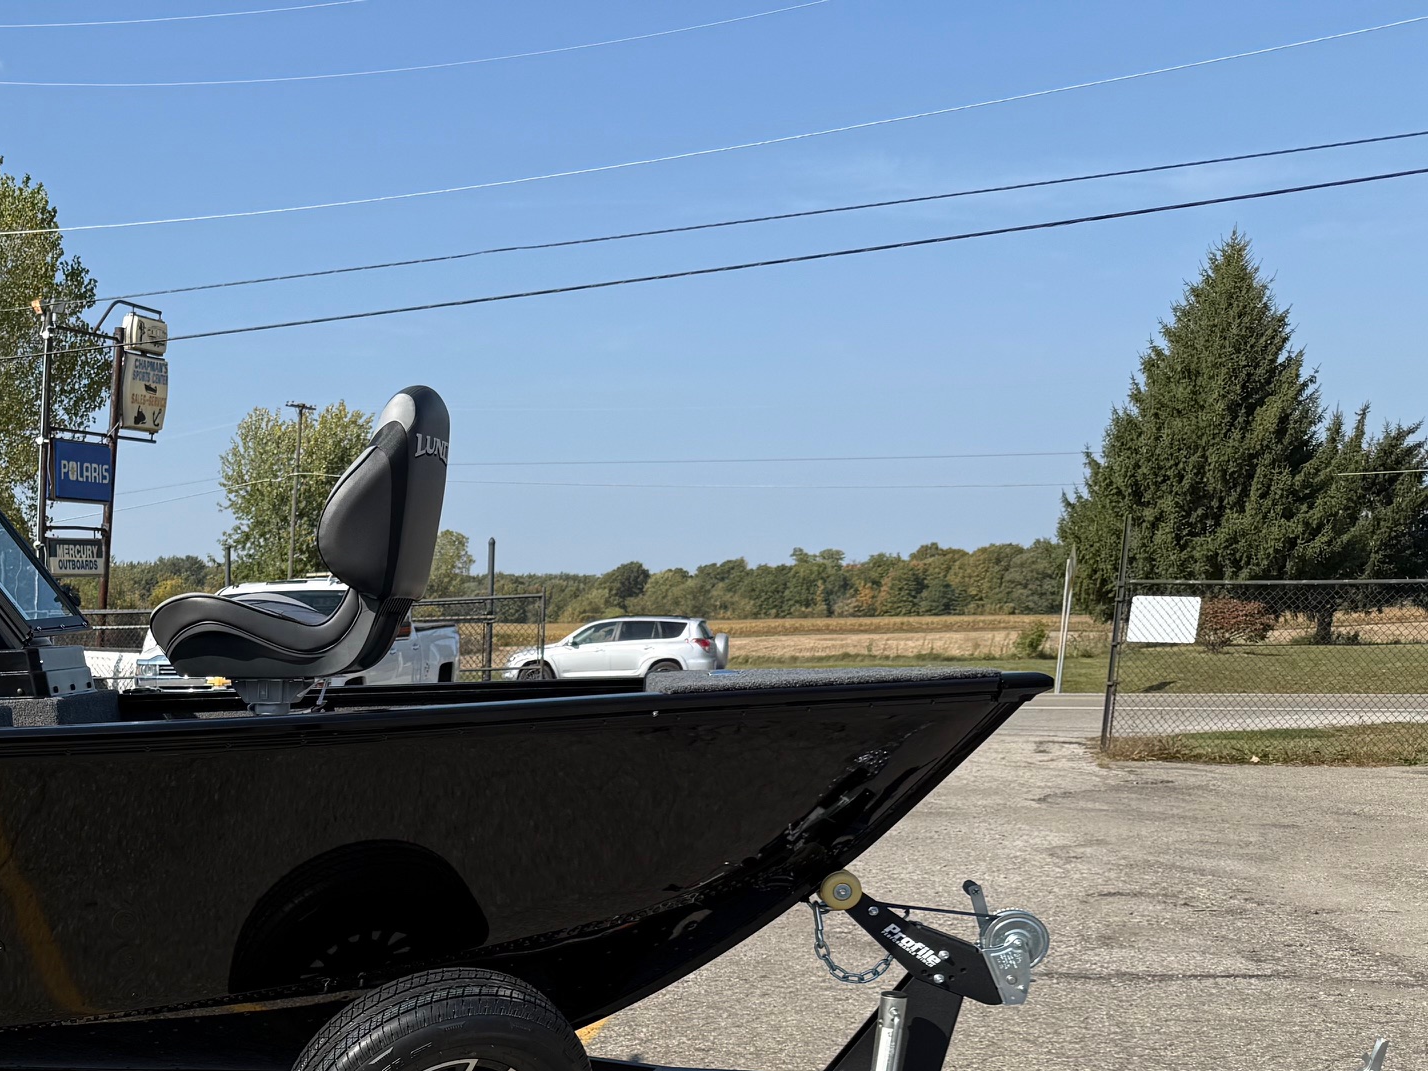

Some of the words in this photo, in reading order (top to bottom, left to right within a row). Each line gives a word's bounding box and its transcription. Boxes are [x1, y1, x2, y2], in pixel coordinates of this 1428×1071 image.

[61, 460, 109, 484] POLARIS
[56, 544, 98, 559] MERCURY
[58, 559, 98, 571] OUTBOARDS
[882, 923, 942, 964] Profile
